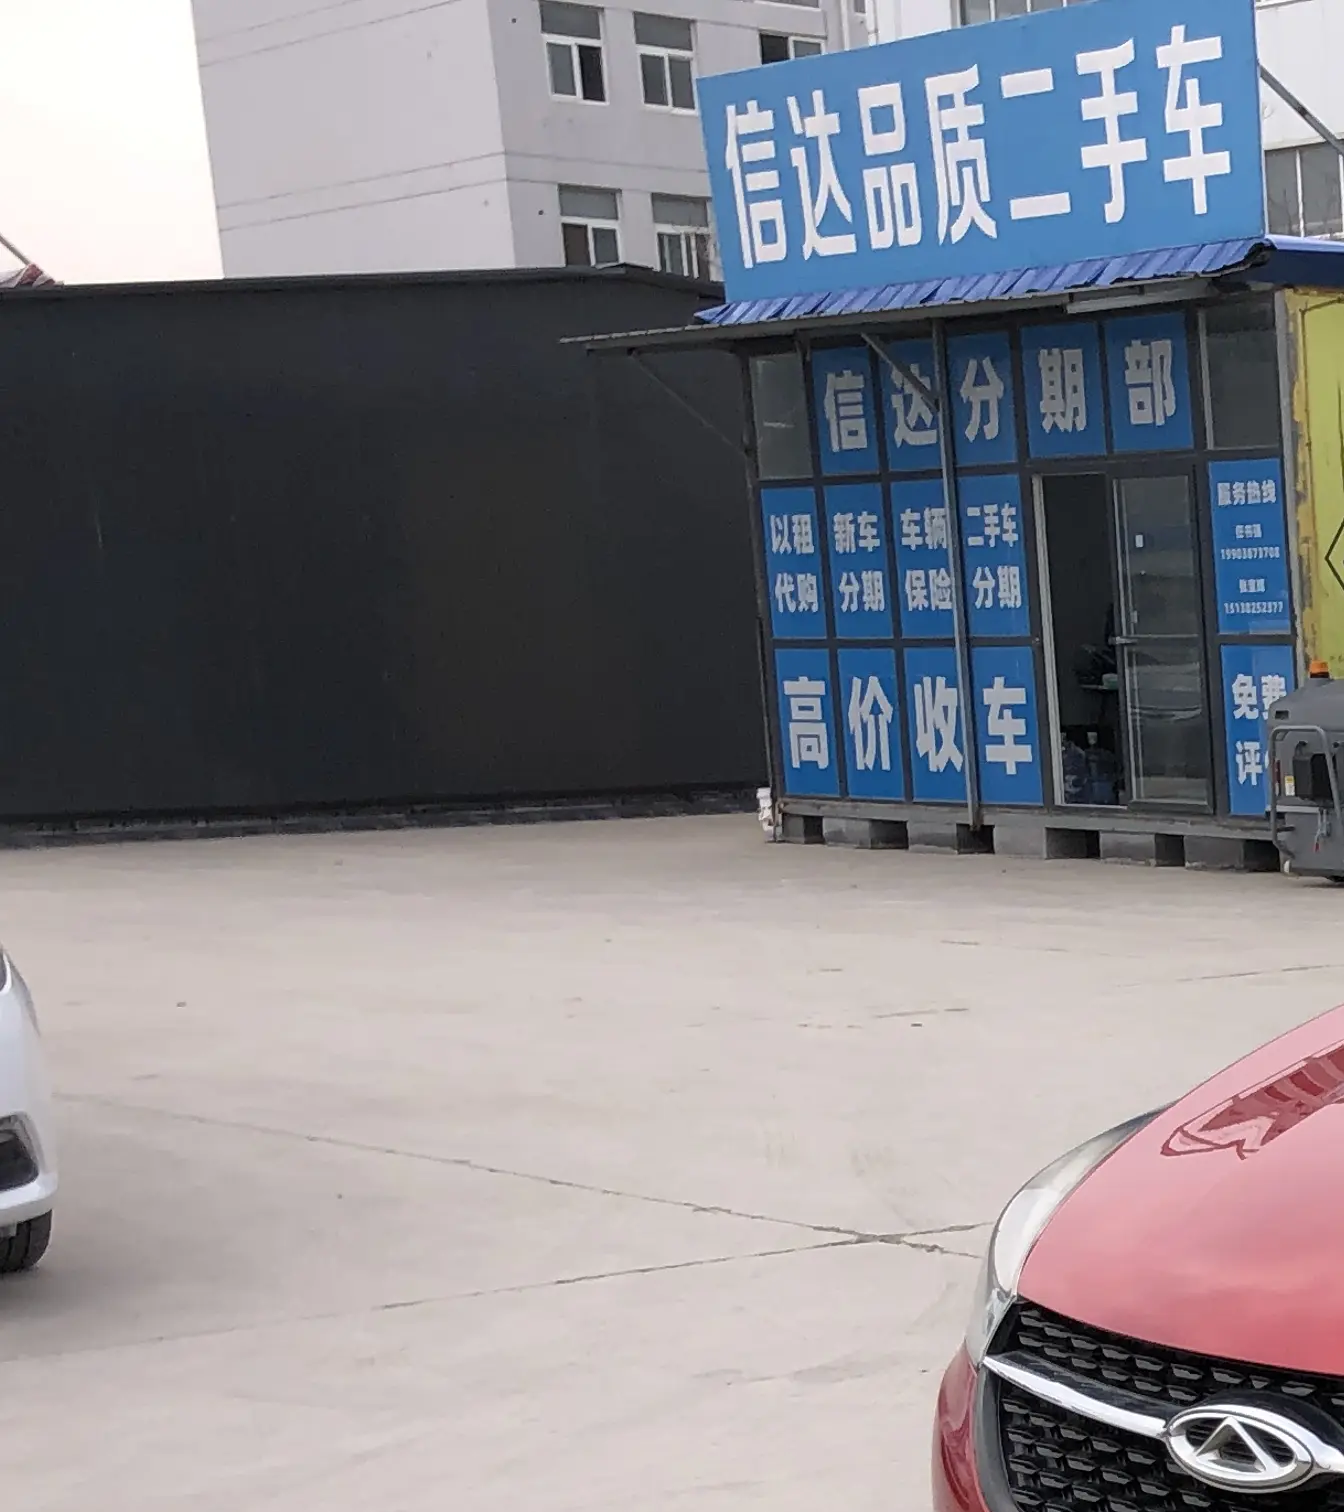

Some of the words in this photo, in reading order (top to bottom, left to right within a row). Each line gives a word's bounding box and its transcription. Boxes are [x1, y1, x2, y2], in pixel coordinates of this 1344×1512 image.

[725, 24, 1231, 268] 信达品质二手车
[824, 339, 1176, 452] 信达分期部
[1216, 479, 1277, 506] 服务热线
[770, 513, 815, 555] 以租
[833, 511, 880, 554] 新车
[900, 508, 947, 550] 车辆
[966, 502, 1019, 548] 二手车
[775, 572, 819, 613] 代购
[838, 570, 885, 613] 分期
[905, 567, 953, 611] 保险
[972, 566, 1021, 609] 分期
[783, 676, 1033, 775] 高价收车
[1235, 740, 1268, 786] 评
